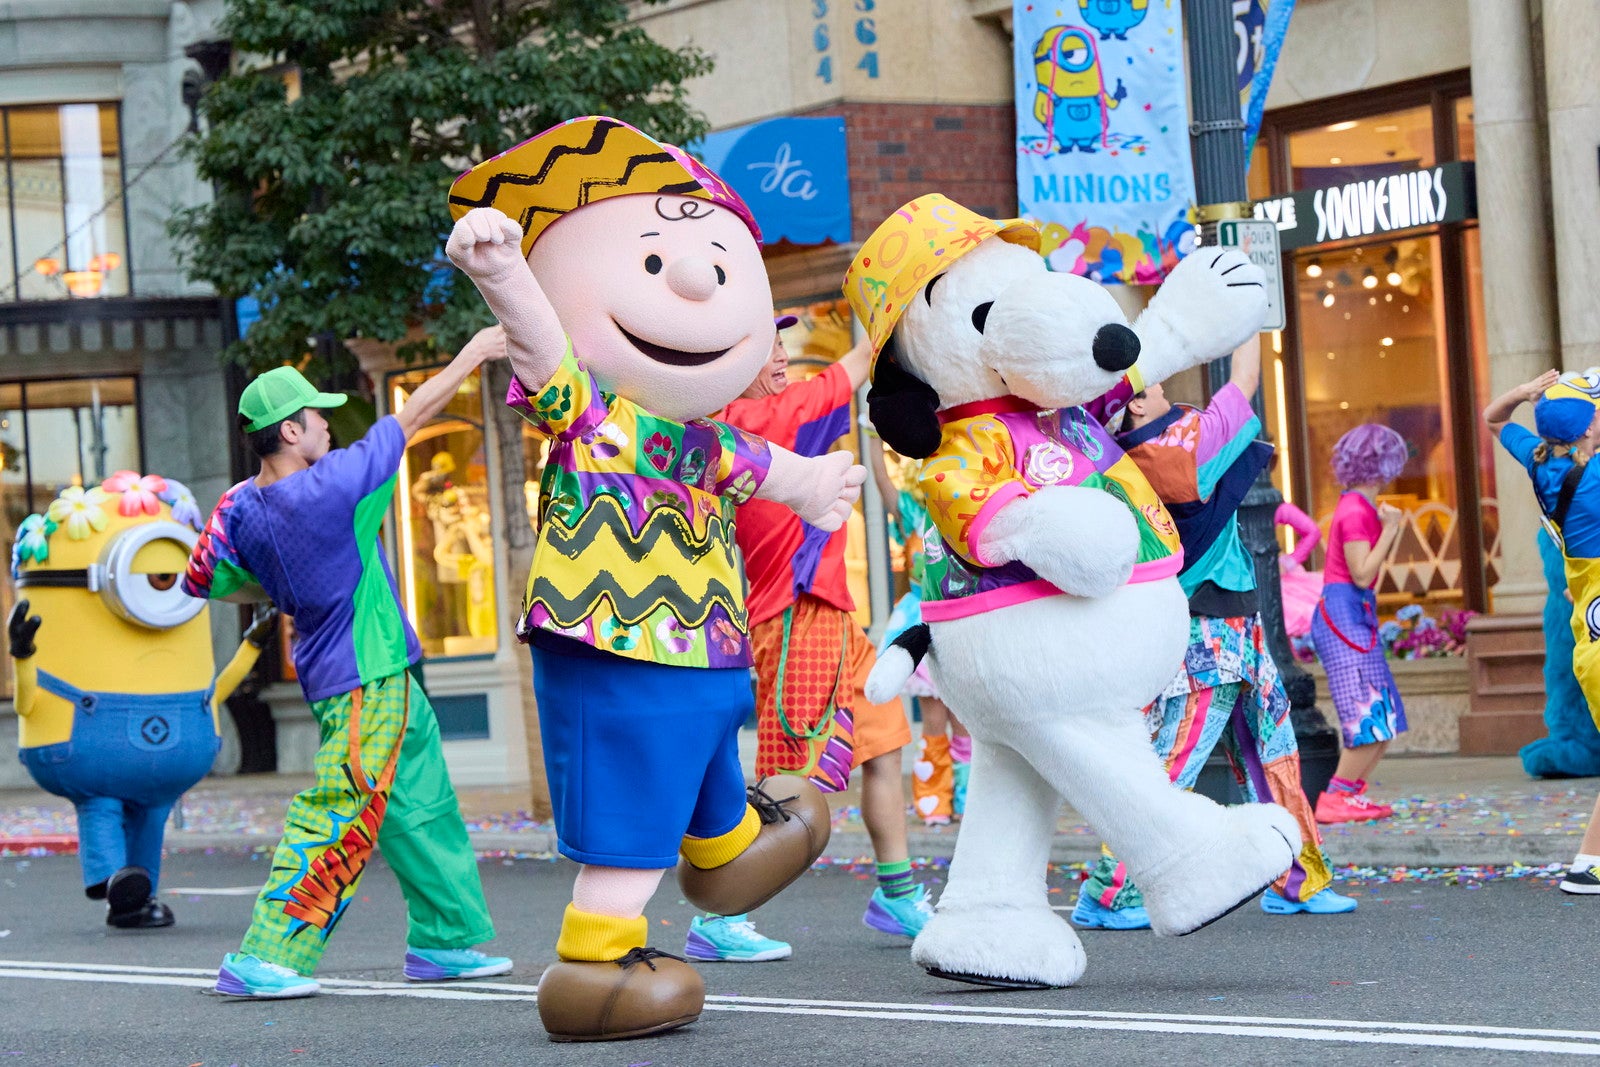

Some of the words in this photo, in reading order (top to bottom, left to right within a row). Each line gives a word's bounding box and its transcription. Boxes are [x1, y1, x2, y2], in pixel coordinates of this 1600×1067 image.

[1033, 173, 1172, 203] MINIONS
[1313, 167, 1447, 242] SOUVENIRS
[1225, 224, 1235, 246] 1
[1248, 250, 1275, 266] KING
